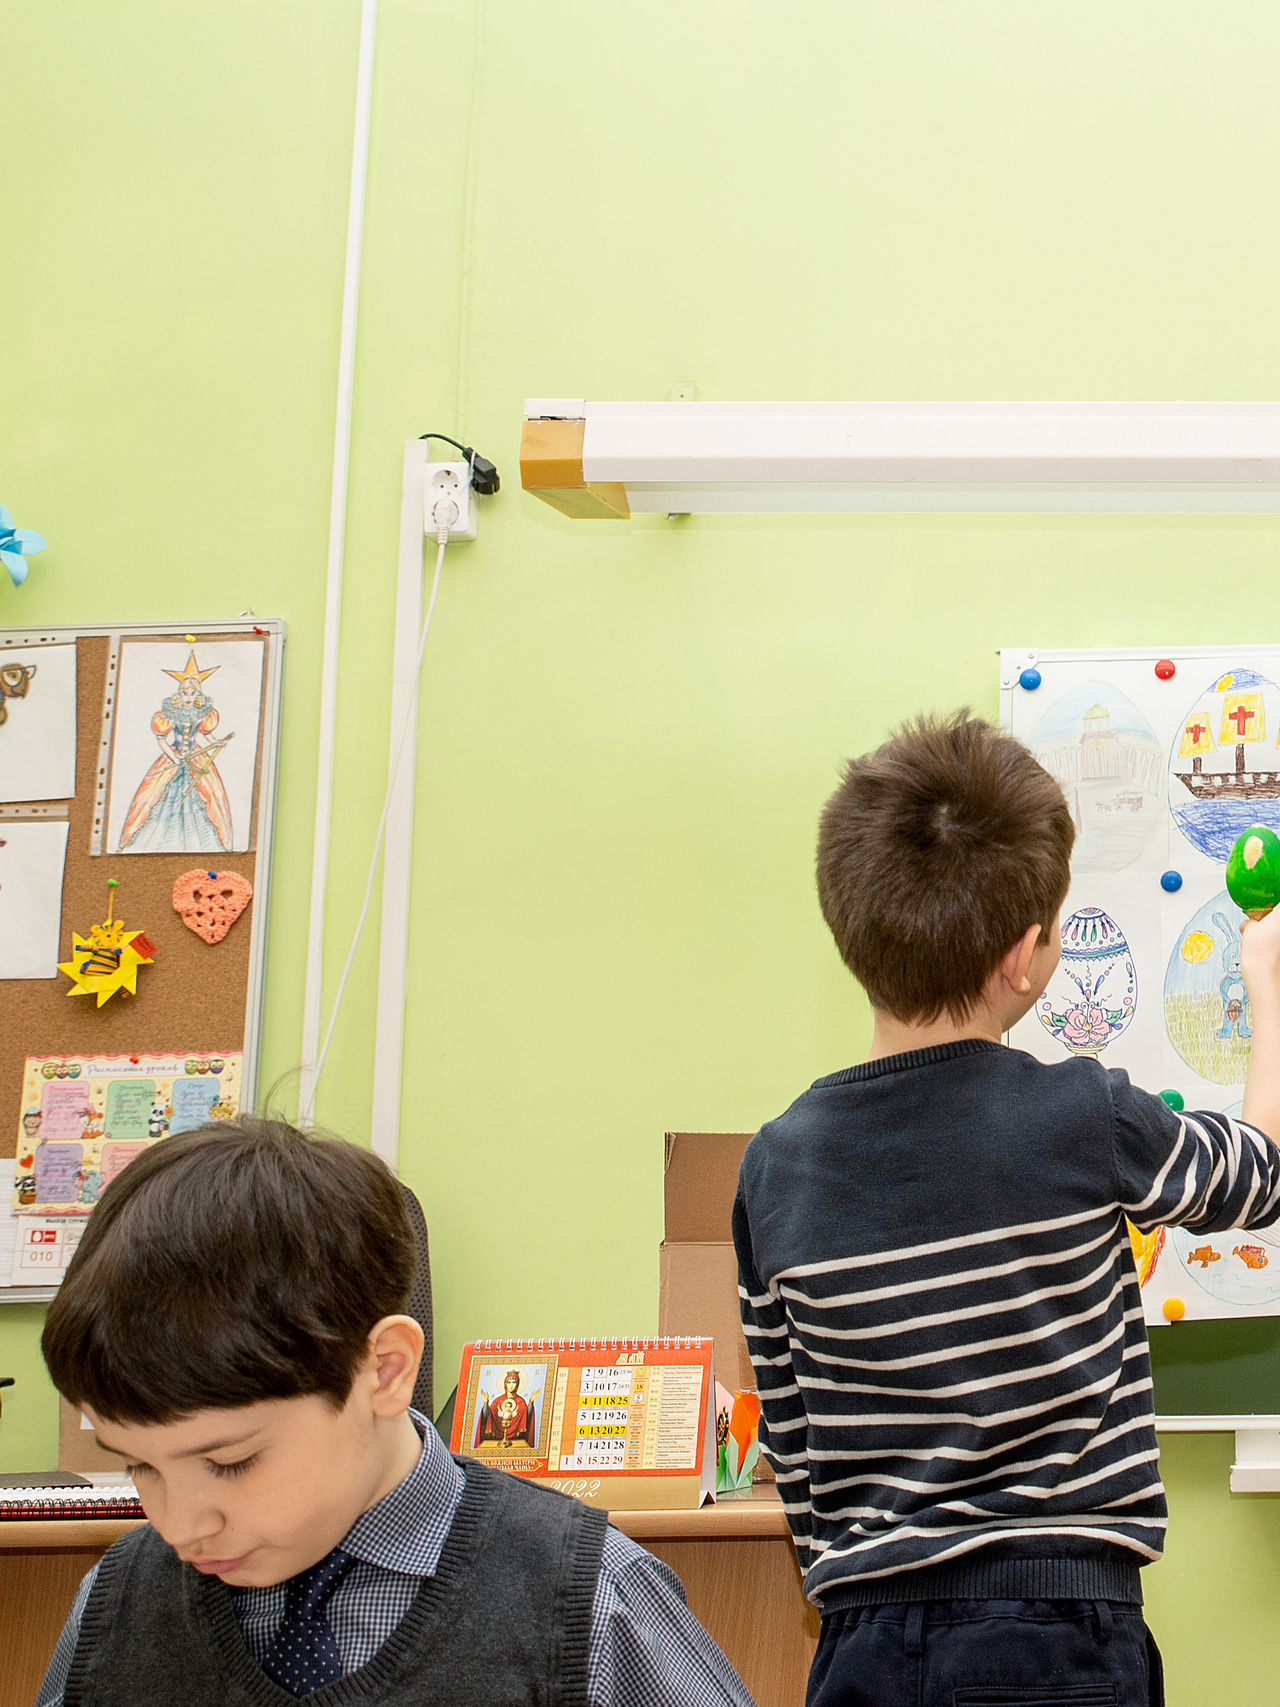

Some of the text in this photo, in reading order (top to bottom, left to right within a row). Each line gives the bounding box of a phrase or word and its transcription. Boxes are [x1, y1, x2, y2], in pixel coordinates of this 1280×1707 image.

[30, 1251, 54, 1261] 010
[585, 1368, 591, 1377] 2
[598, 1368, 604, 1376] 9
[609, 1368, 619, 1376] 16
[585, 1382, 590, 1391] 3
[594, 1383, 605, 1391] 10
[607, 1382, 617, 1391] 17
[582, 1397, 588, 1405] 4
[593, 1397, 602, 1405] 11
[605, 1397, 616, 1405] 18
[617, 1397, 628, 1405] 25
[580, 1412, 587, 1420] 5
[591, 1412, 602, 1420] 12
[604, 1412, 614, 1420] 19
[616, 1411, 627, 1420] 26
[579, 1427, 585, 1435] 6
[590, 1427, 600, 1435] 13
[602, 1426, 613, 1435] 20
[614, 1426, 626, 1434] 27
[578, 1441, 584, 1450] 7
[588, 1441, 599, 1449] 14
[601, 1441, 611, 1449] 21
[613, 1440, 625, 1449] 28
[565, 1457, 569, 1465] 1
[576, 1456, 582, 1465] 8
[588, 1456, 598, 1465] 15
[600, 1456, 610, 1465] 22
[611, 1456, 623, 1464] 29
[551, 1479, 601, 1498] 2022
